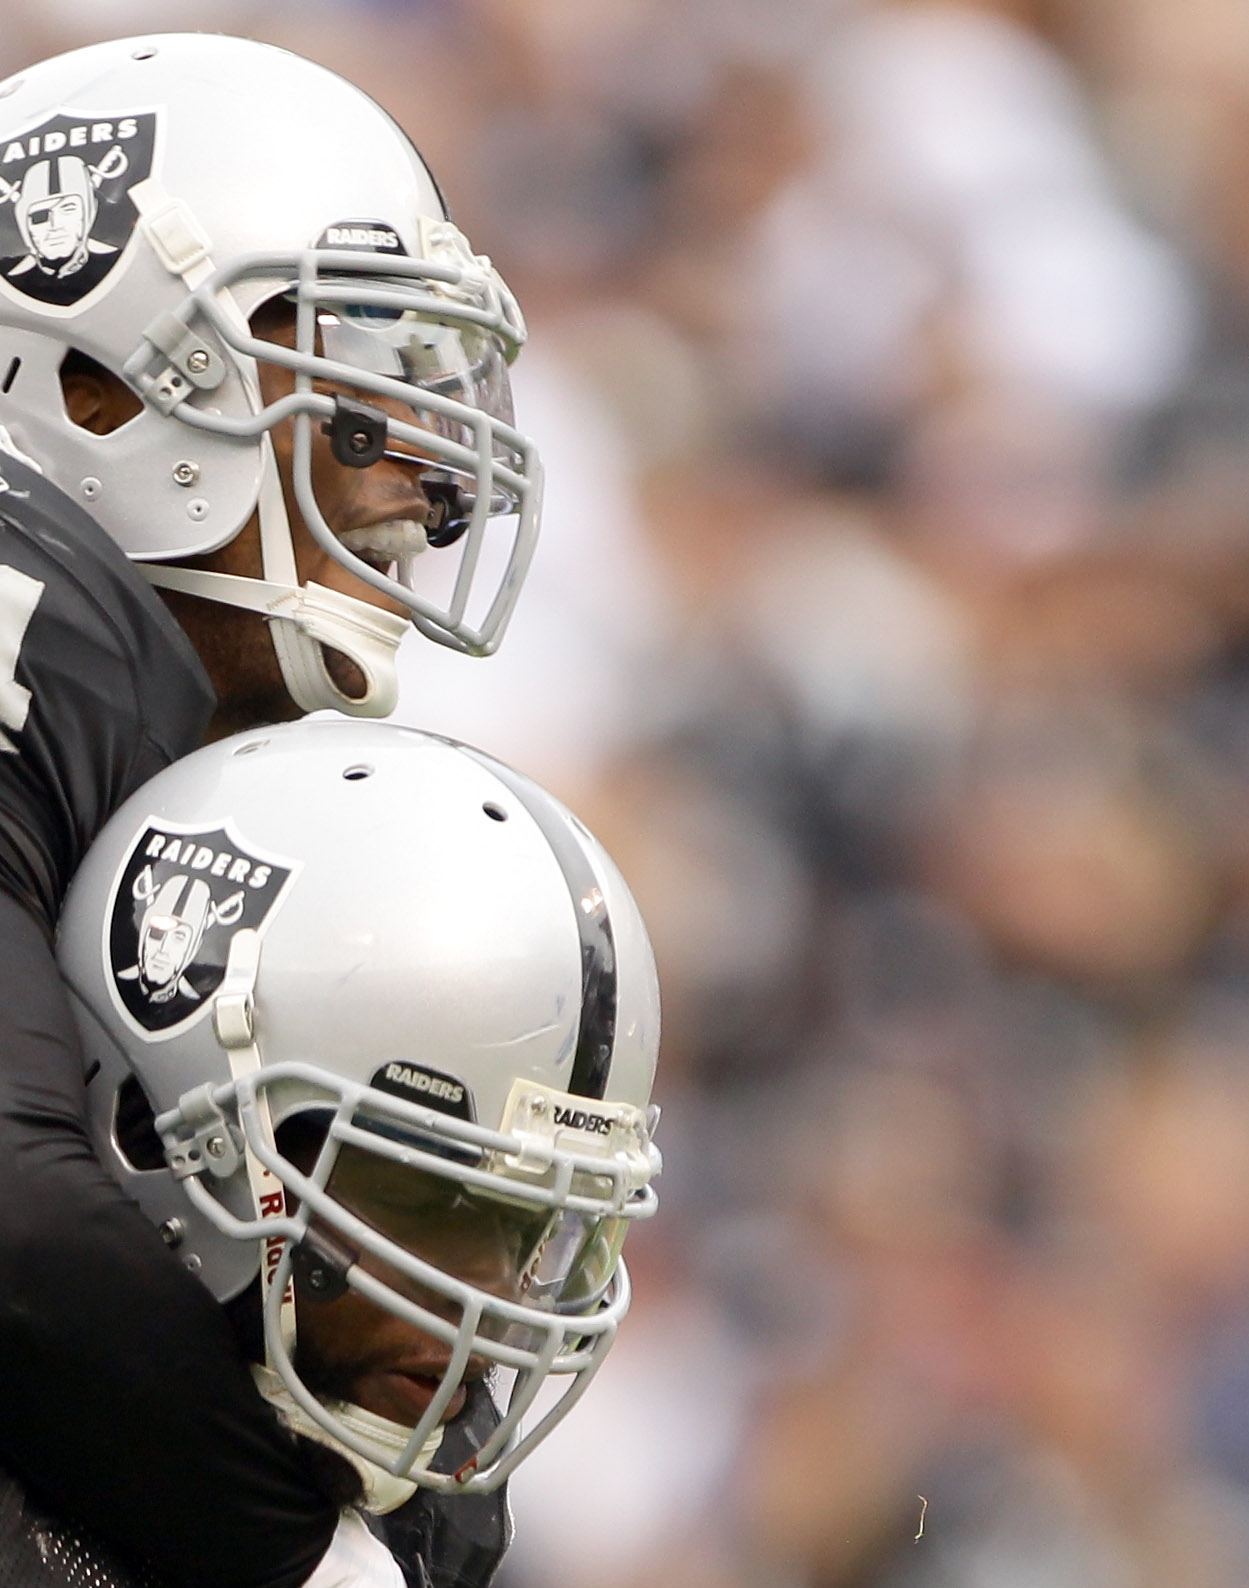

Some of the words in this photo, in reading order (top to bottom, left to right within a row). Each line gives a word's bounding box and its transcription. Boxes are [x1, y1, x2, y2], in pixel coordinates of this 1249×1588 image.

[326, 227, 400, 249] RAIDERS
[145, 833, 273, 889] RAIDERS
[385, 1062, 464, 1103] RAIDERS
[553, 1105, 615, 1136] RAIDERS
